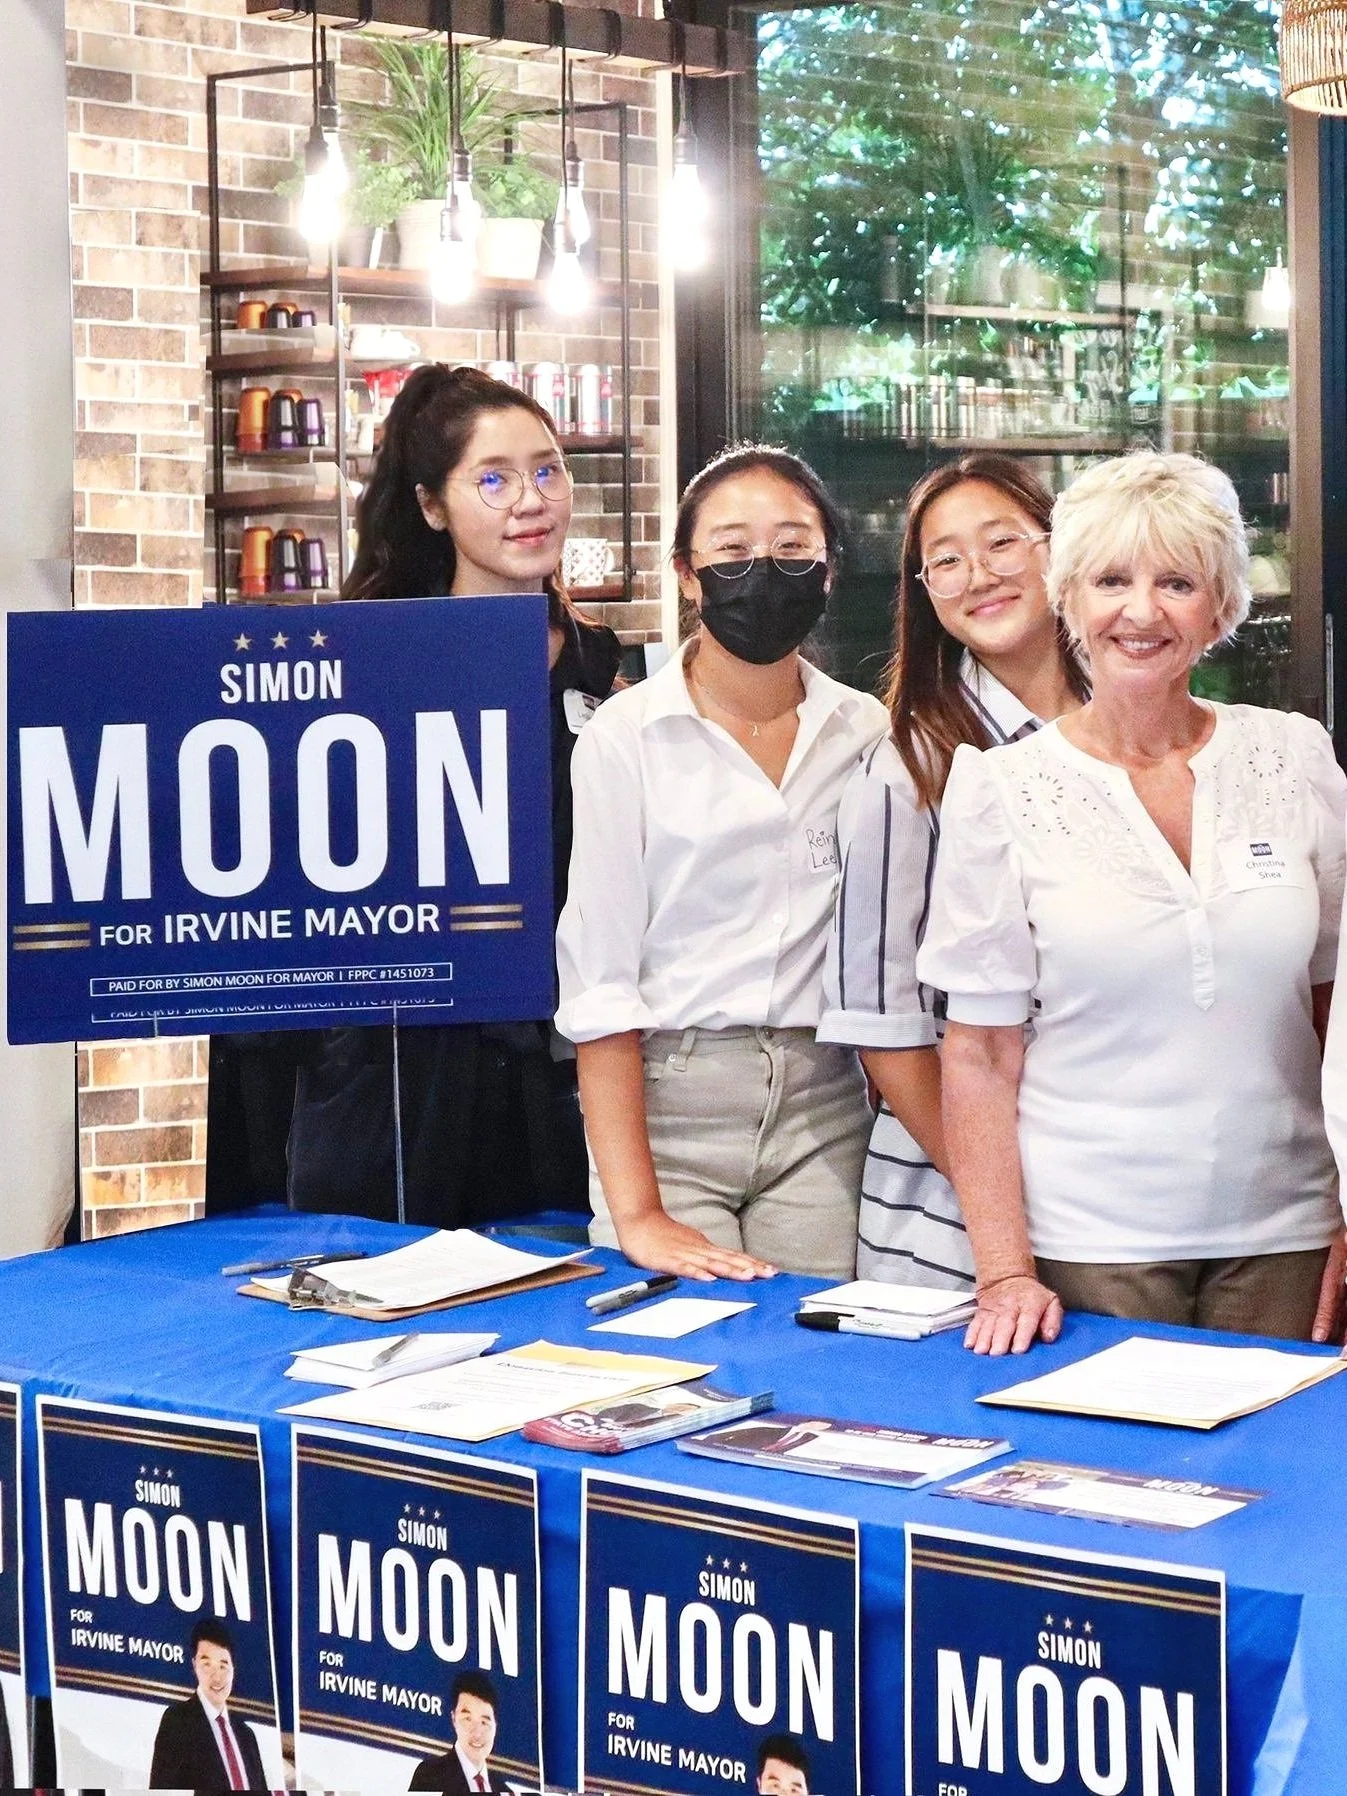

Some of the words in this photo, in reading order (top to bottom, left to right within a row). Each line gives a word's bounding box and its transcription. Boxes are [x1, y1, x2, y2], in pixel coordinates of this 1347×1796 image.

[220, 660, 342, 704] SIMON
[19, 709, 510, 904] MOON
[1258, 872, 1282, 880] Shea
[100, 924, 152, 946] FOR
[165, 909, 292, 943] IRVINE
[305, 903, 439, 938] MAYOR
[109, 981, 136, 992] PAID
[139, 979, 163, 991] FOR
[165, 978, 180, 989] BY
[183, 976, 222, 989] SIMON
[225, 974, 264, 987] MOON
[267, 973, 290, 984] FOR
[292, 970, 335, 983] MAYOR
[348, 969, 377, 981] FPPC
[379, 967, 435, 980] #1451073
[135, 1479, 181, 1508] SIMON
[397, 1518, 448, 1551] SIMON
[64, 1498, 251, 1622] MOON
[318, 1533, 519, 1678] MOON
[698, 1570, 756, 1606] SIMON
[70, 1609, 93, 1624] FOR
[71, 1629, 125, 1653] IRVINE
[128, 1636, 184, 1664] MAYOR
[319, 1650, 343, 1668] FOR
[608, 1587, 834, 1742] MOON
[1037, 1630, 1102, 1670] SIMON
[319, 1671, 377, 1701] IRVINE
[382, 1684, 443, 1717] MAYOR
[608, 1712, 635, 1730] FOR
[938, 1649, 1195, 1796] MOON
[608, 1734, 672, 1766] IRVINE
[678, 1747, 746, 1784] MAYOR
